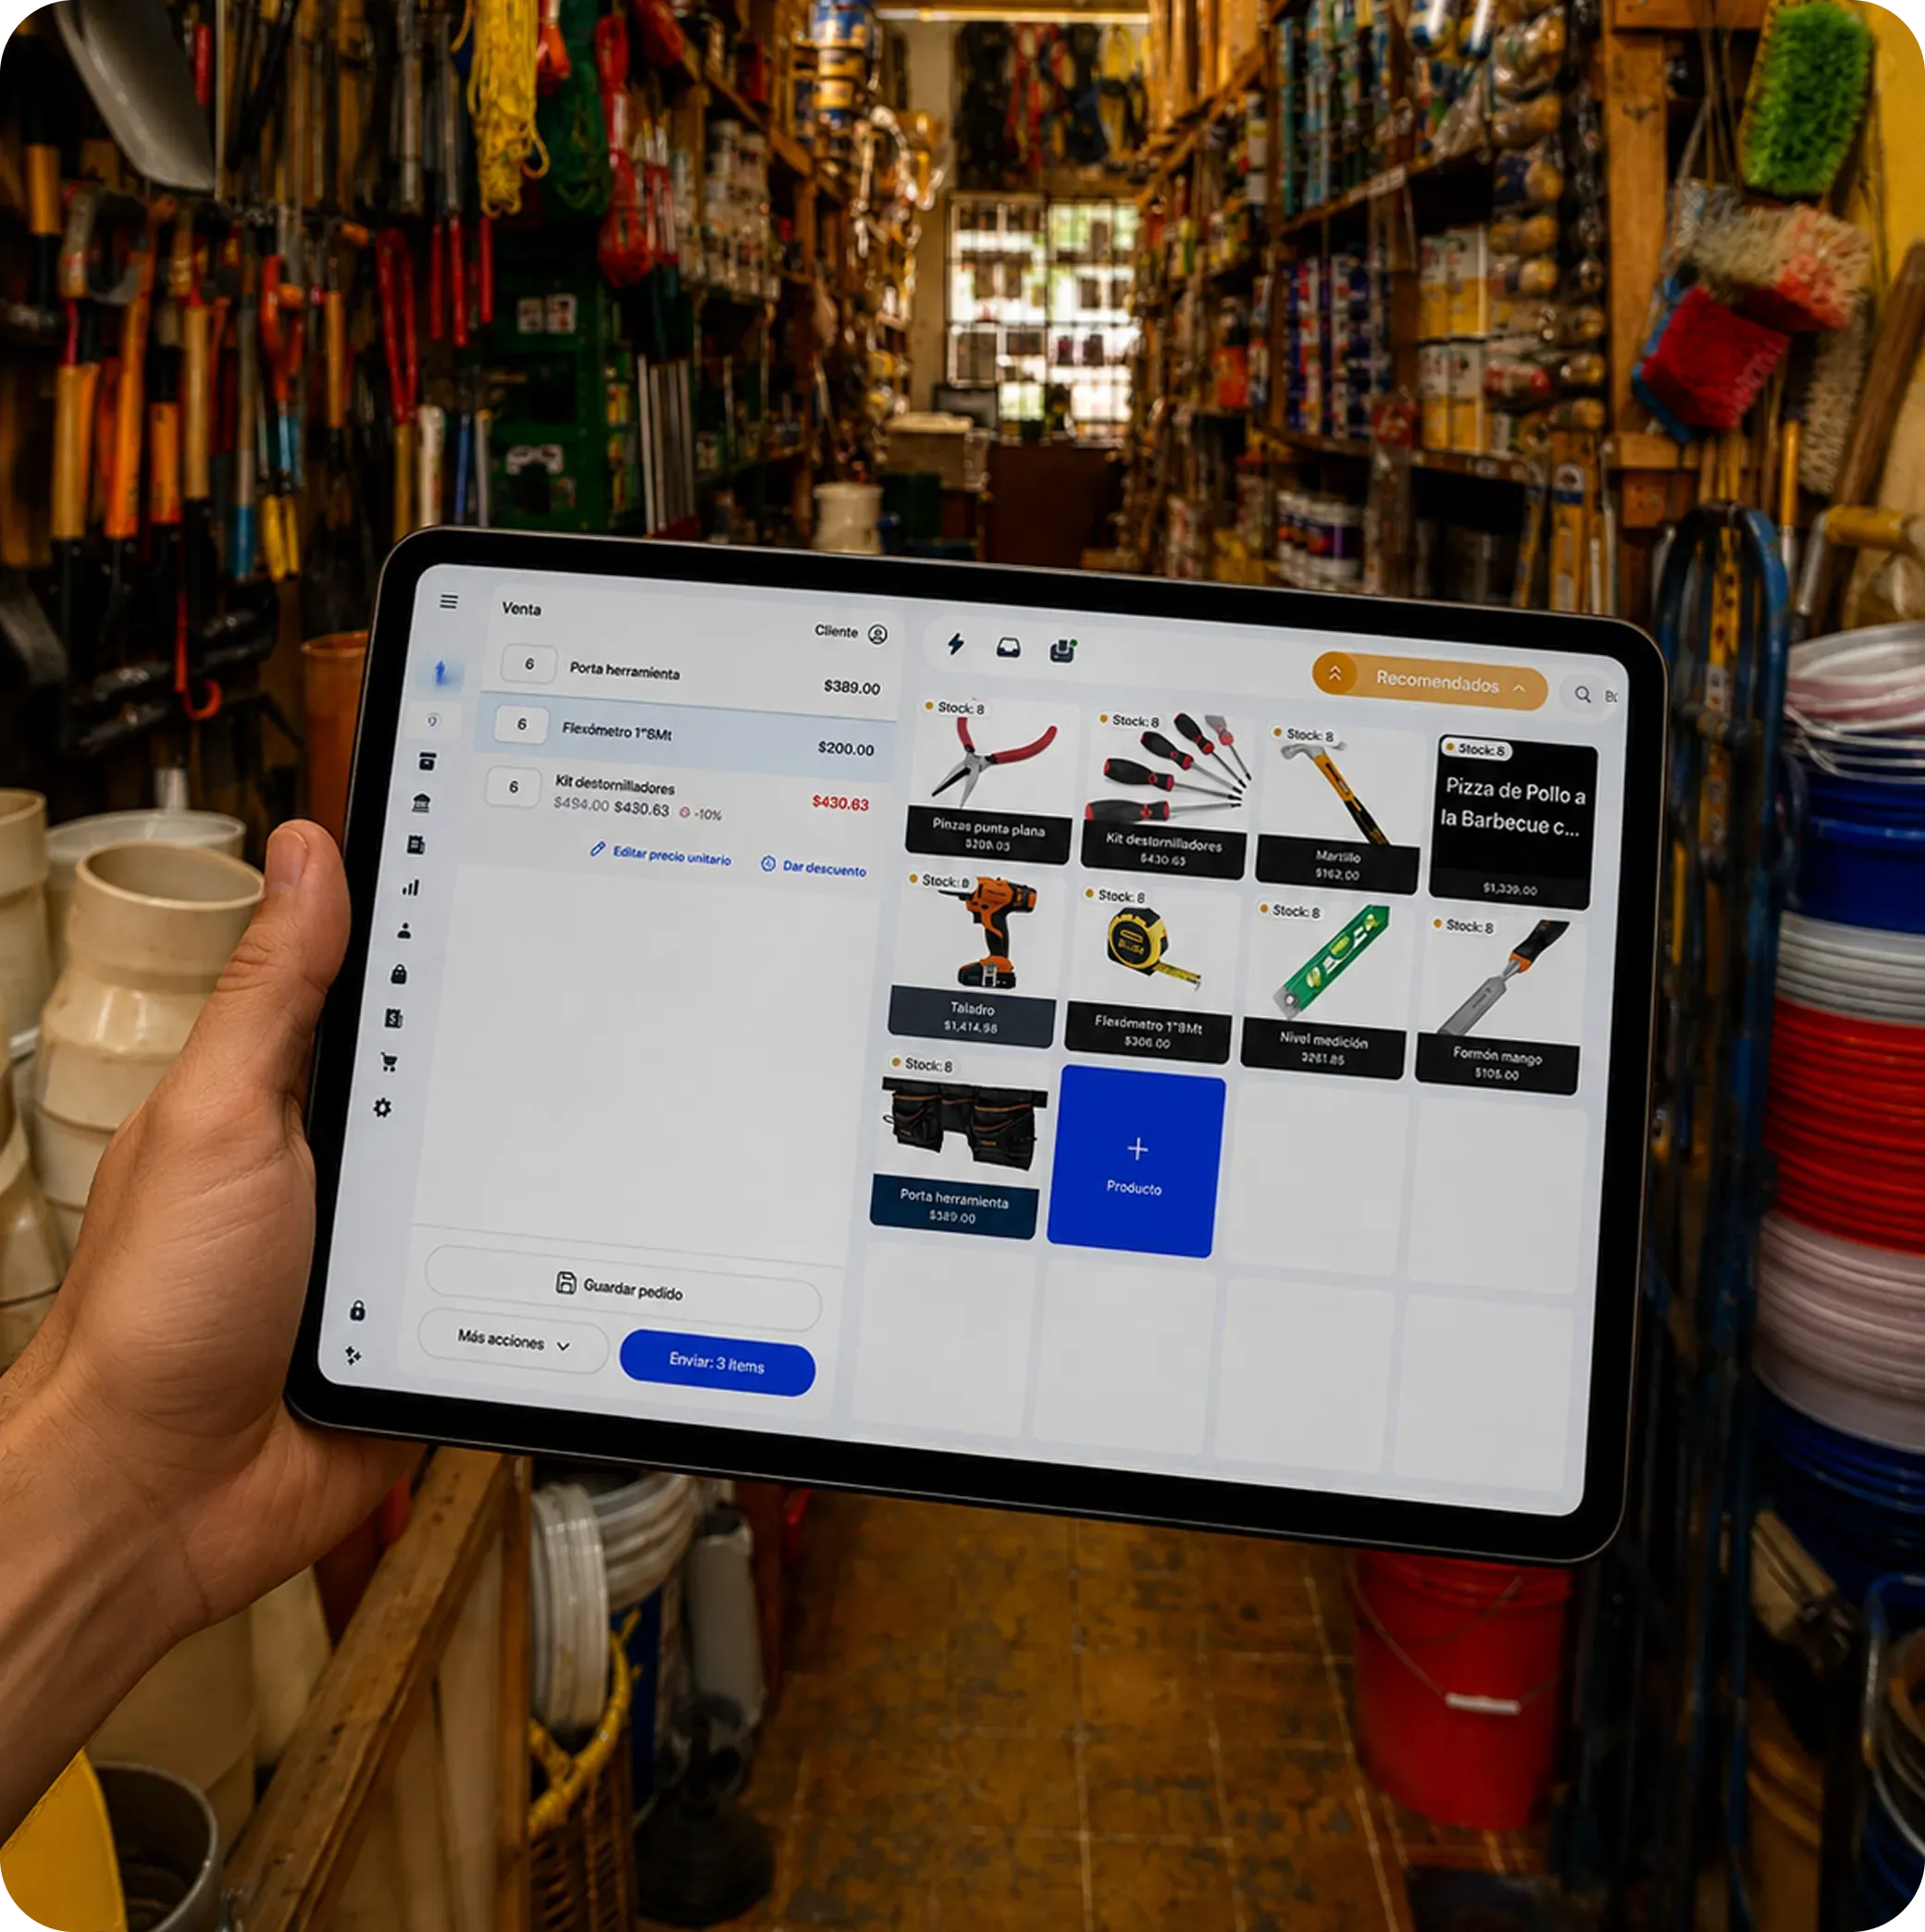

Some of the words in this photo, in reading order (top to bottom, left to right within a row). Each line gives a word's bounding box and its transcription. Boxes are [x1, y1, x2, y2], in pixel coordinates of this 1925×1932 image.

[502, 601, 542, 617] Venta
[814, 624, 859, 638] Cliente
[525, 657, 535, 671] 6
[569, 661, 604, 675] Porta
[605, 663, 680, 681] herramienta
[824, 678, 881, 696] $389.00
[1376, 669, 1500, 694] Recomendados
[938, 700, 974, 714] Stock:
[976, 704, 985, 715] 8
[516, 717, 528, 731] 6
[562, 721, 633, 738] Flexómetro
[1112, 713, 1149, 727] Stock:
[1150, 716, 1160, 729] 8
[1286, 727, 1322, 741] Stock:
[1325, 731, 1335, 743] 8
[817, 740, 875, 757] $200.00
[1459, 742, 1497, 756] Stock:
[1496, 746, 1506, 757] 8
[509, 780, 519, 794] 6
[555, 774, 574, 787] Kit
[574, 776, 676, 796] destornilladores
[1446, 776, 1495, 798] Pizza
[1498, 782, 1522, 800] de
[1525, 783, 1571, 804] Pollo
[1574, 791, 1586, 805] a
[614, 800, 670, 818] $430.63
[694, 808, 723, 822] -10%
[812, 794, 870, 812] $430.63
[932, 816, 972, 832] Pinzas
[974, 823, 1010, 836] punta
[1011, 824, 1046, 837] plana
[1440, 808, 1458, 826] la
[1461, 809, 1550, 835] Barbecue
[1106, 832, 1124, 845] Kit
[1125, 834, 1223, 853] destornilladores
[613, 845, 648, 859] Editar
[649, 849, 686, 865] precio
[687, 853, 732, 867] unitario
[783, 860, 804, 873] Dar
[805, 861, 867, 878] descuento
[922, 873, 961, 888] Stock:
[1099, 889, 1136, 903] Stock:
[1136, 892, 1146, 904] 8
[1273, 904, 1310, 918] Stock:
[1311, 907, 1321, 920] 8
[1447, 918, 1483, 933] Stock:
[1484, 922, 1494, 935] 8
[950, 1000, 996, 1017] Taladro
[1094, 1013, 1164, 1033] Flexómetro
[1280, 1031, 1311, 1045] Nivel
[1312, 1035, 1369, 1049] medición
[905, 1057, 942, 1072] Stock:
[944, 1060, 953, 1073] 8
[1453, 1045, 1499, 1061] Formón
[1500, 1052, 1544, 1068] mango
[1106, 1179, 1162, 1196] Producto
[900, 1187, 933, 1203] Porta
[935, 1191, 1010, 1210] herramienta
[583, 1277, 637, 1295] Guardar
[638, 1286, 684, 1302] pedido
[457, 1329, 486, 1344] Más
[487, 1334, 545, 1351] acciones
[669, 1351, 714, 1368] Enviar:
[715, 1356, 727, 1370] 3
